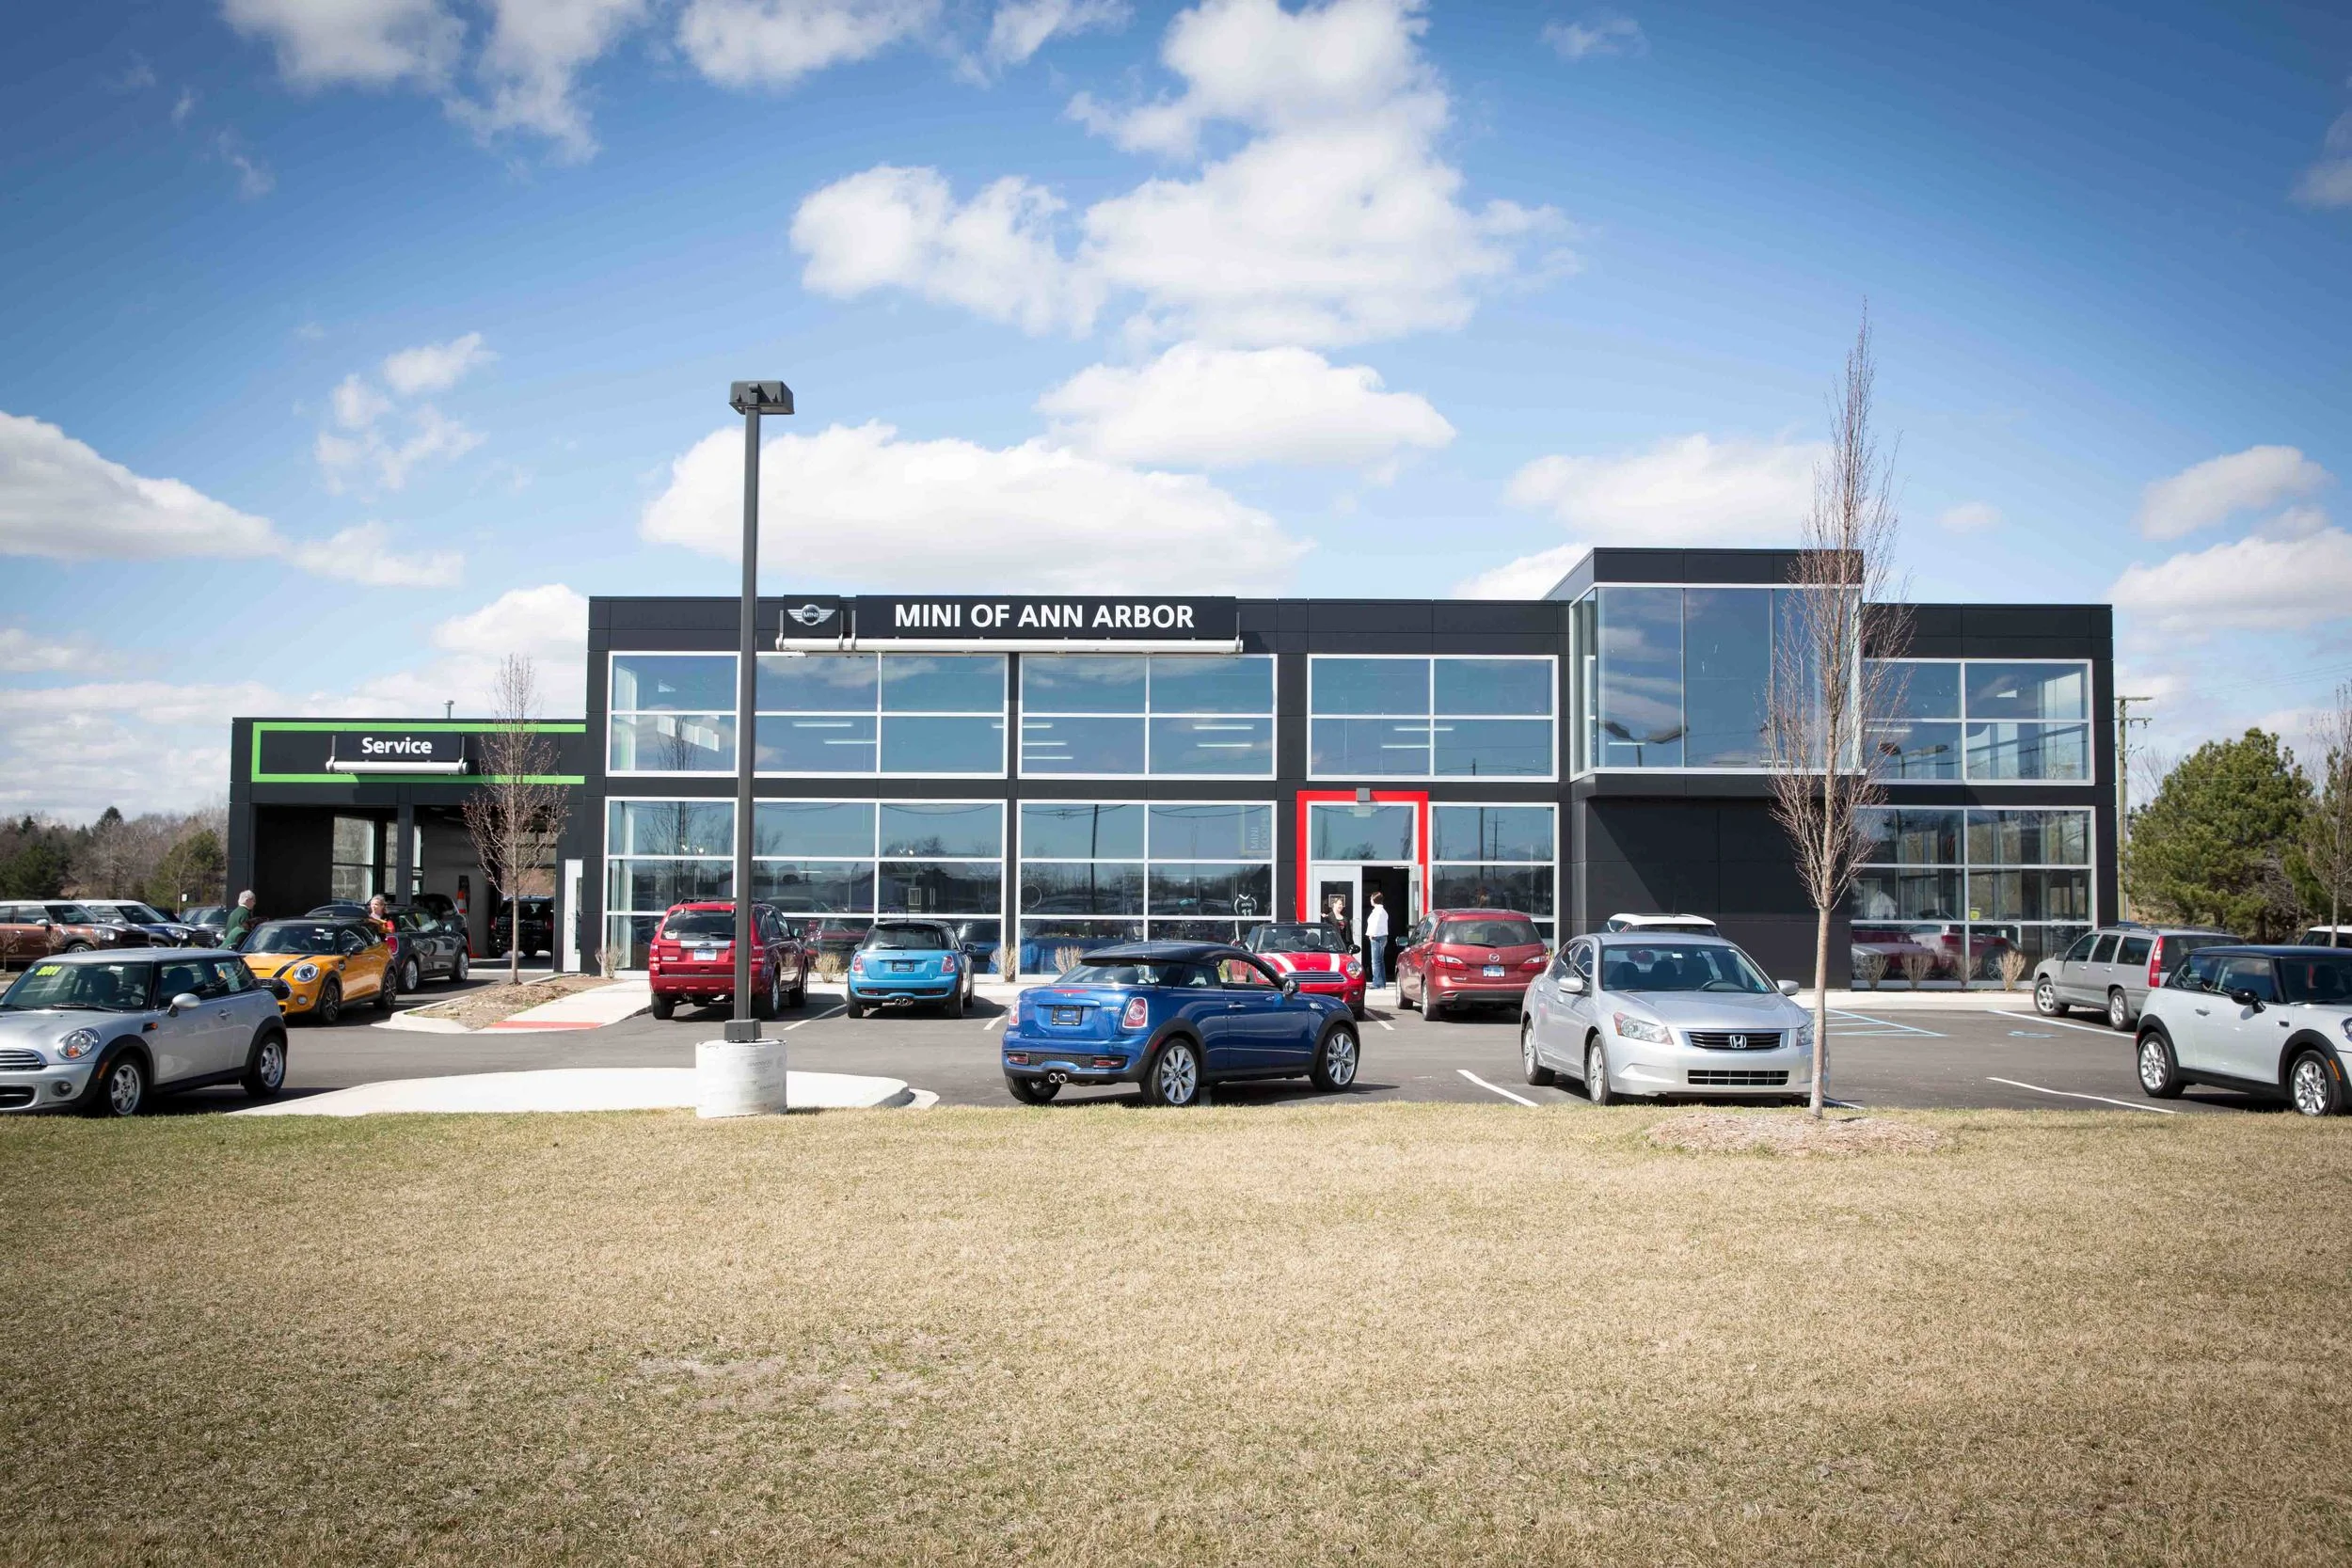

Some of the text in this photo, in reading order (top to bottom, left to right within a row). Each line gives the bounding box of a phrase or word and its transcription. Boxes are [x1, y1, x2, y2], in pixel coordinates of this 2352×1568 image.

[895, 604, 1195, 628] MINI OF ANN ARBOR
[361, 736, 433, 754] Service
